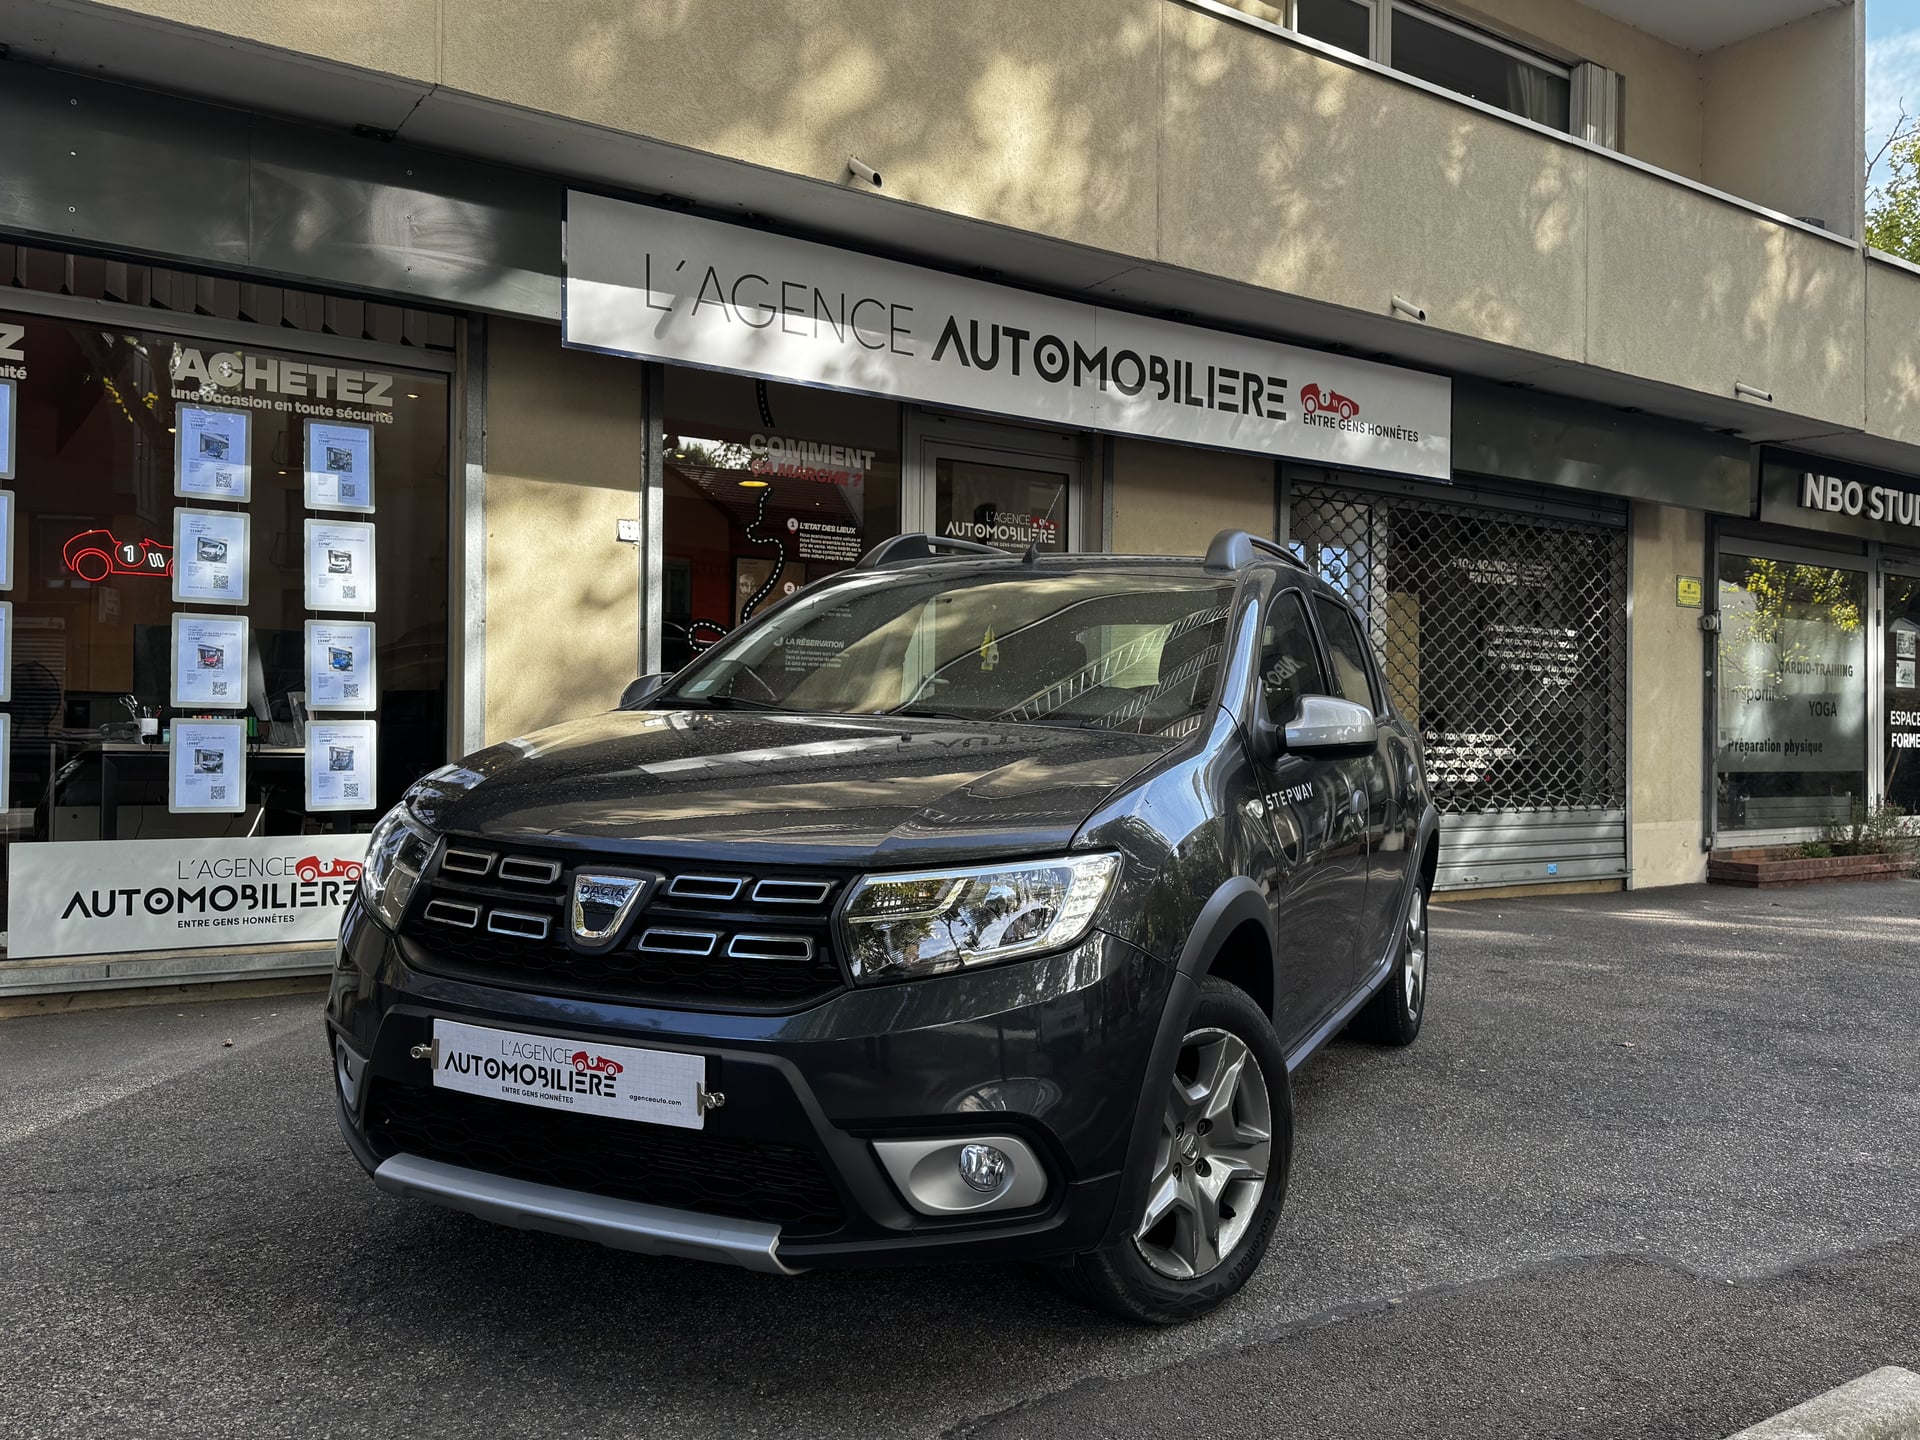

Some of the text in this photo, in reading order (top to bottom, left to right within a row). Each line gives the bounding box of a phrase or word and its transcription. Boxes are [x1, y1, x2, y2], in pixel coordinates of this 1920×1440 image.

[174, 348, 393, 407] ACHETEZ
[171, 388, 393, 424] une occasion en toute sécurité
[1303, 412, 1419, 443] ENTRE GENS HONNÊTES
[750, 434, 876, 470] COMMENT
[777, 463, 850, 487] MARCHE
[1803, 472, 1863, 516] NBO
[822, 524, 836, 533] DES
[836, 526, 856, 534] LIEUX
[1778, 661, 1853, 677] CARDIO-TRAINING
[1809, 701, 1837, 717] YOGA
[1890, 710, 1920, 726] ESPACE
[1728, 738, 1823, 756] Préparation physique
[1265, 781, 1314, 811] STEPWAY
[580, 885, 626, 898] DACIA
[178, 913, 295, 929] ENTRE GENS HONNÊTES
[501, 1086, 574, 1104] ENTRE GENS HONNÊTES
[629, 1093, 682, 1106] agenceauto.com
